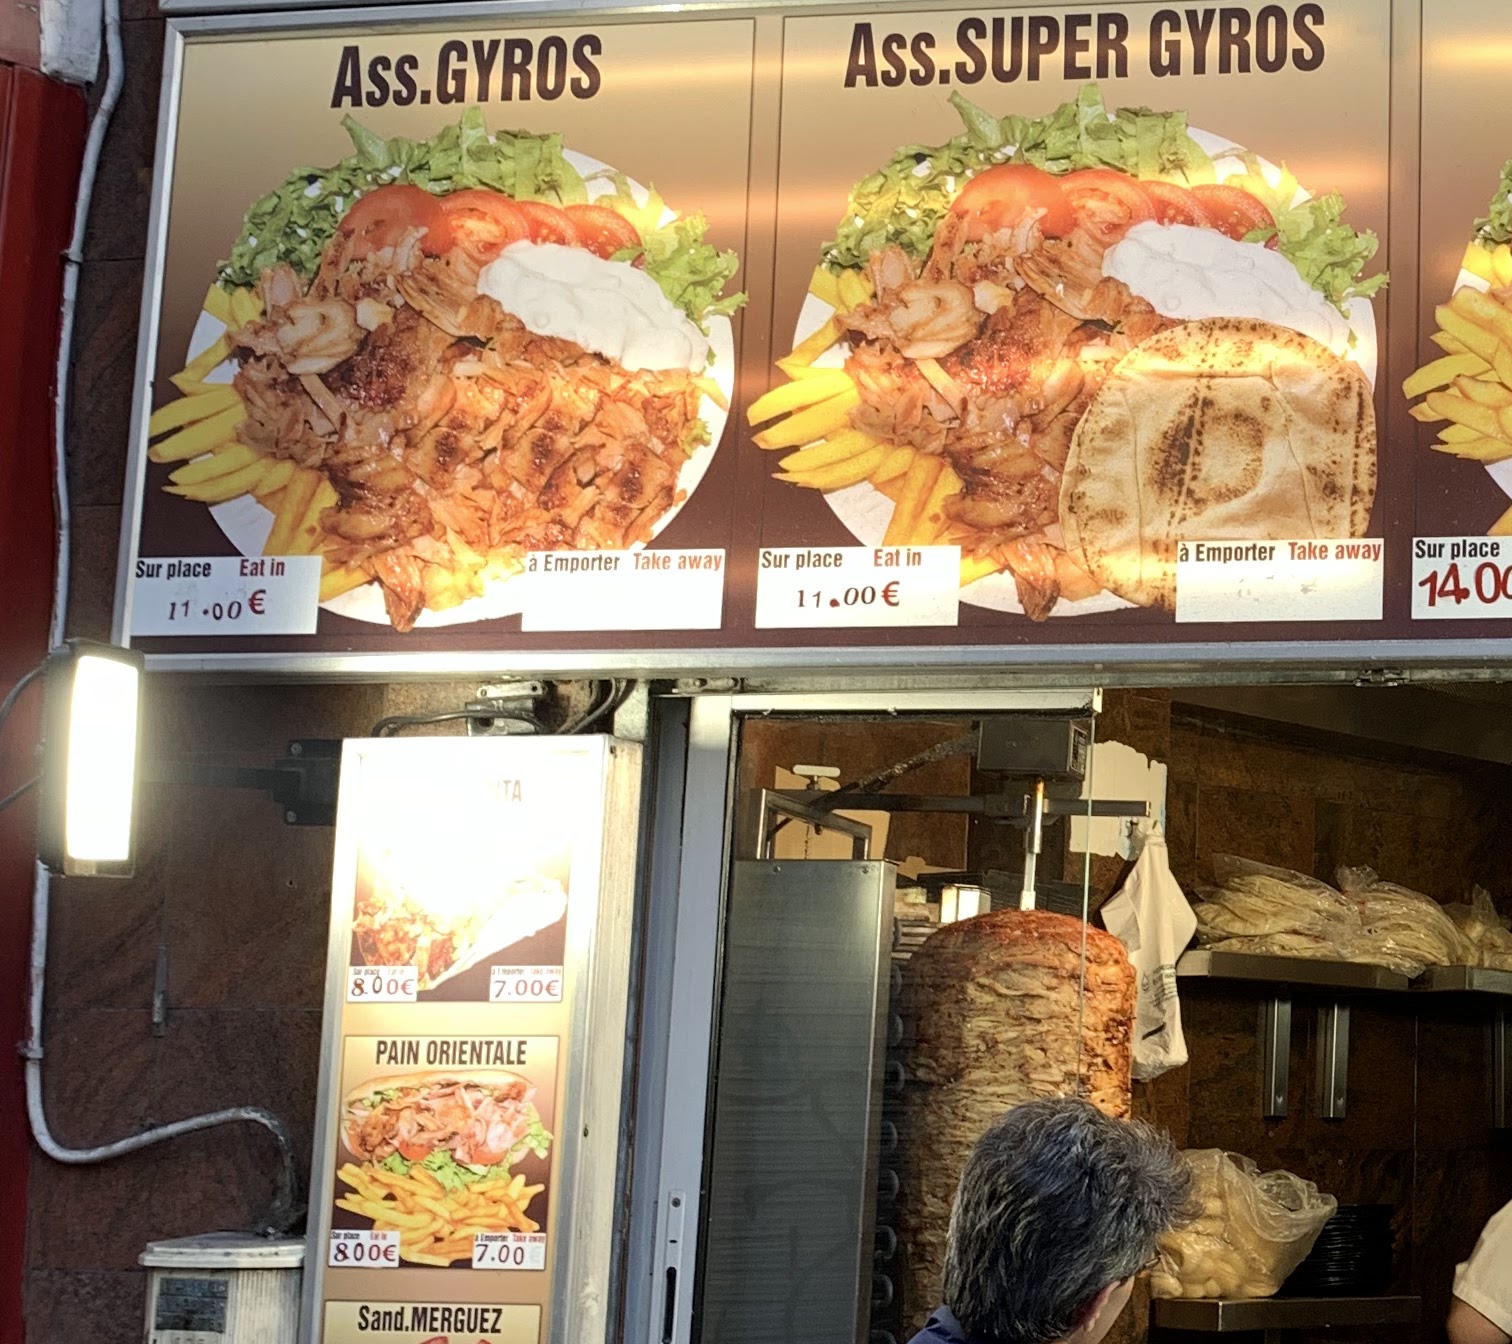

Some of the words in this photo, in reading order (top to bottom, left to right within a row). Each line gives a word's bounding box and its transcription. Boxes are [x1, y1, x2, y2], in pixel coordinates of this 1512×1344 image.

[1146, 4, 1326, 78] GYROS
[761, 550, 791, 570] Sur
[796, 549, 843, 572] place
[873, 548, 901, 568] Eat
[905, 548, 922, 567] in
[1179, 542, 1189, 563] à
[1195, 542, 1276, 564] Emporter
[1288, 541, 1329, 561] Take
[1335, 541, 1382, 563] away
[1415, 539, 1445, 560] Sur
[1451, 538, 1500, 561] place
[135, 558, 163, 579] Sur
[167, 558, 211, 581] place
[240, 559, 267, 578] Eat
[270, 558, 286, 577] in
[528, 553, 537, 572] à
[543, 552, 620, 575] Emporter
[633, 552, 673, 571] Take
[678, 554, 723, 573] away
[376, 1040, 420, 1066] PAIN
[426, 1040, 528, 1066] ORIENTALE
[357, 1305, 503, 1334] Sand.MERGUEZ
